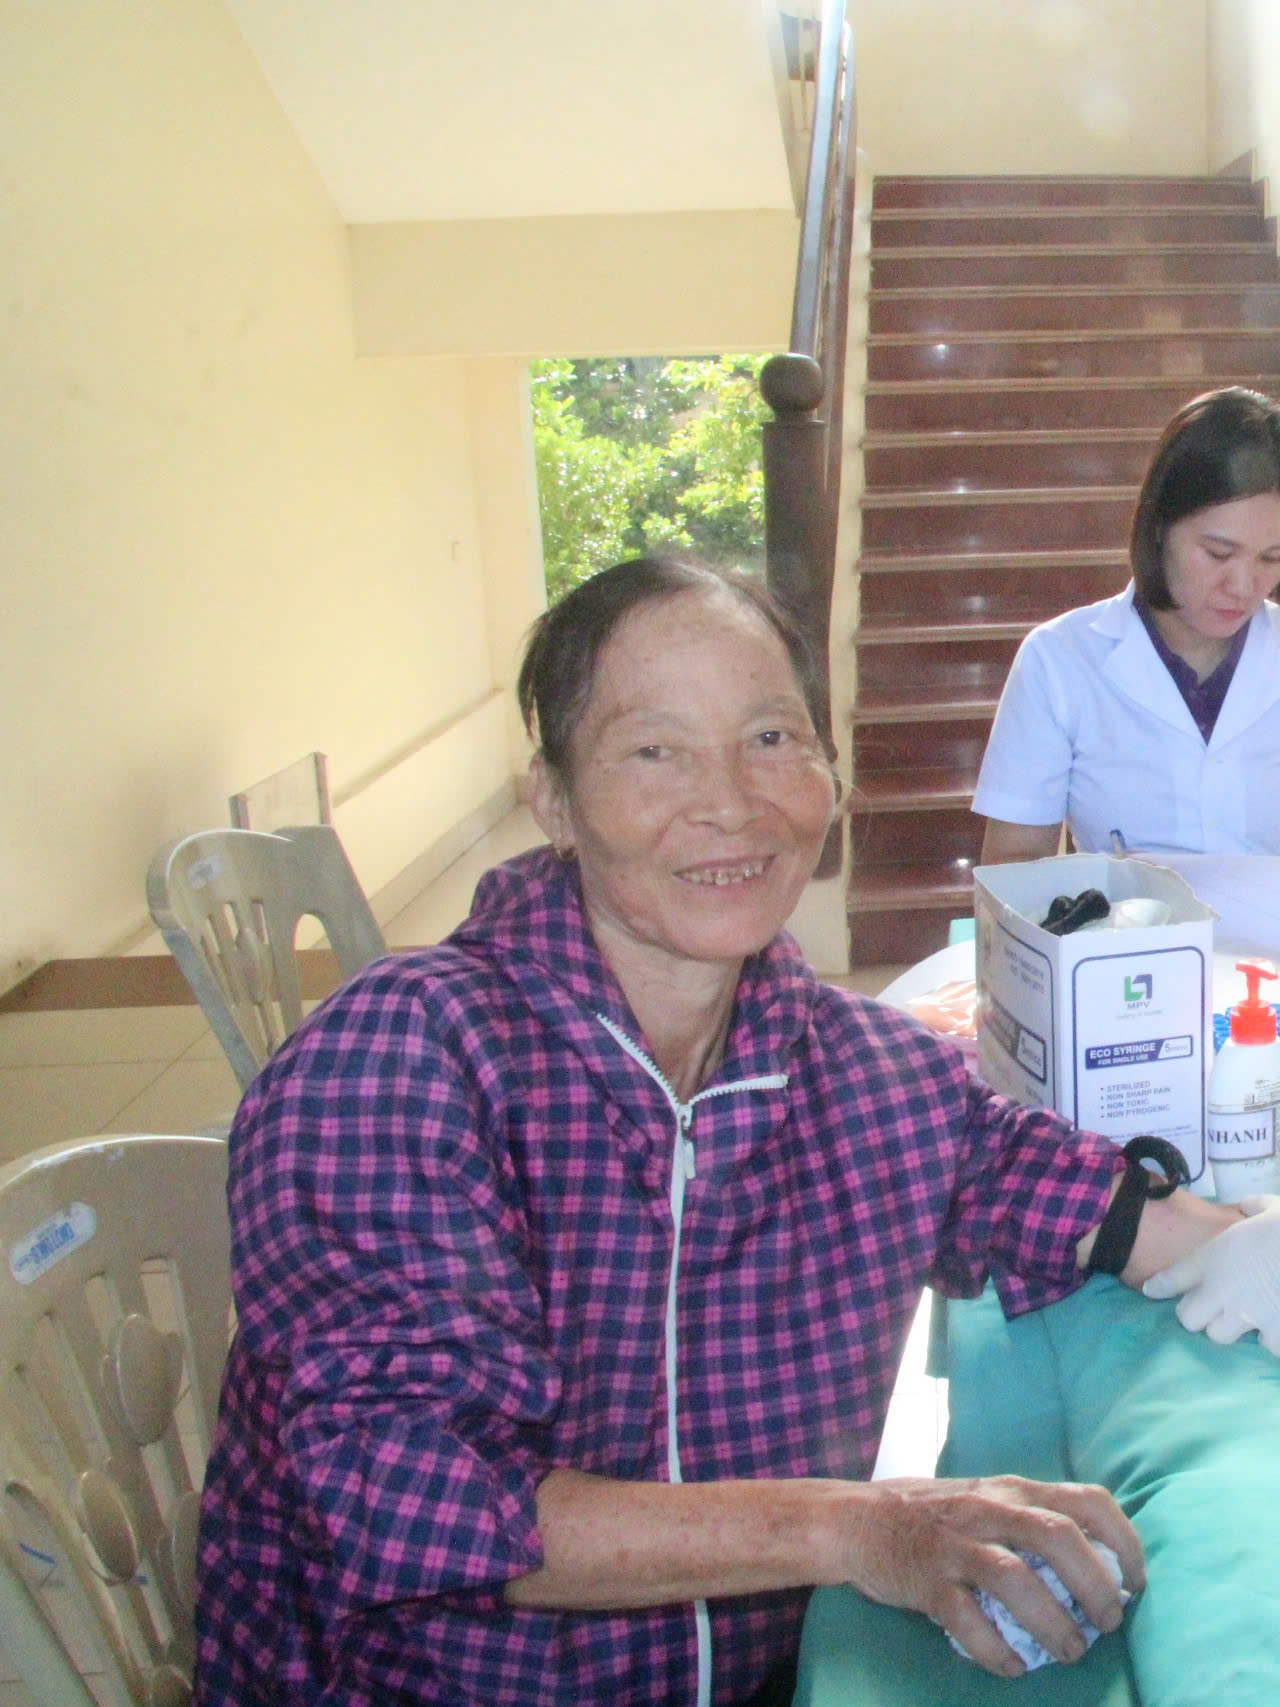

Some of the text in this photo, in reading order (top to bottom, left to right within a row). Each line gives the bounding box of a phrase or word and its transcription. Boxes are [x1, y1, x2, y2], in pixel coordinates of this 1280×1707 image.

[1127, 1001, 1151, 1010] MPV
[1089, 1048, 1112, 1060] ECO
[1113, 1042, 1157, 1056] SYRINGE
[1098, 1053, 1149, 1066] FOR SINGLE USE
[1106, 1080, 1151, 1093] STERILIZED
[1106, 1086, 1171, 1101] NON SHARP PAIN
[1106, 1098, 1150, 1110] NON TOXIC
[1106, 1103, 1171, 1119] NON PYROGENIC
